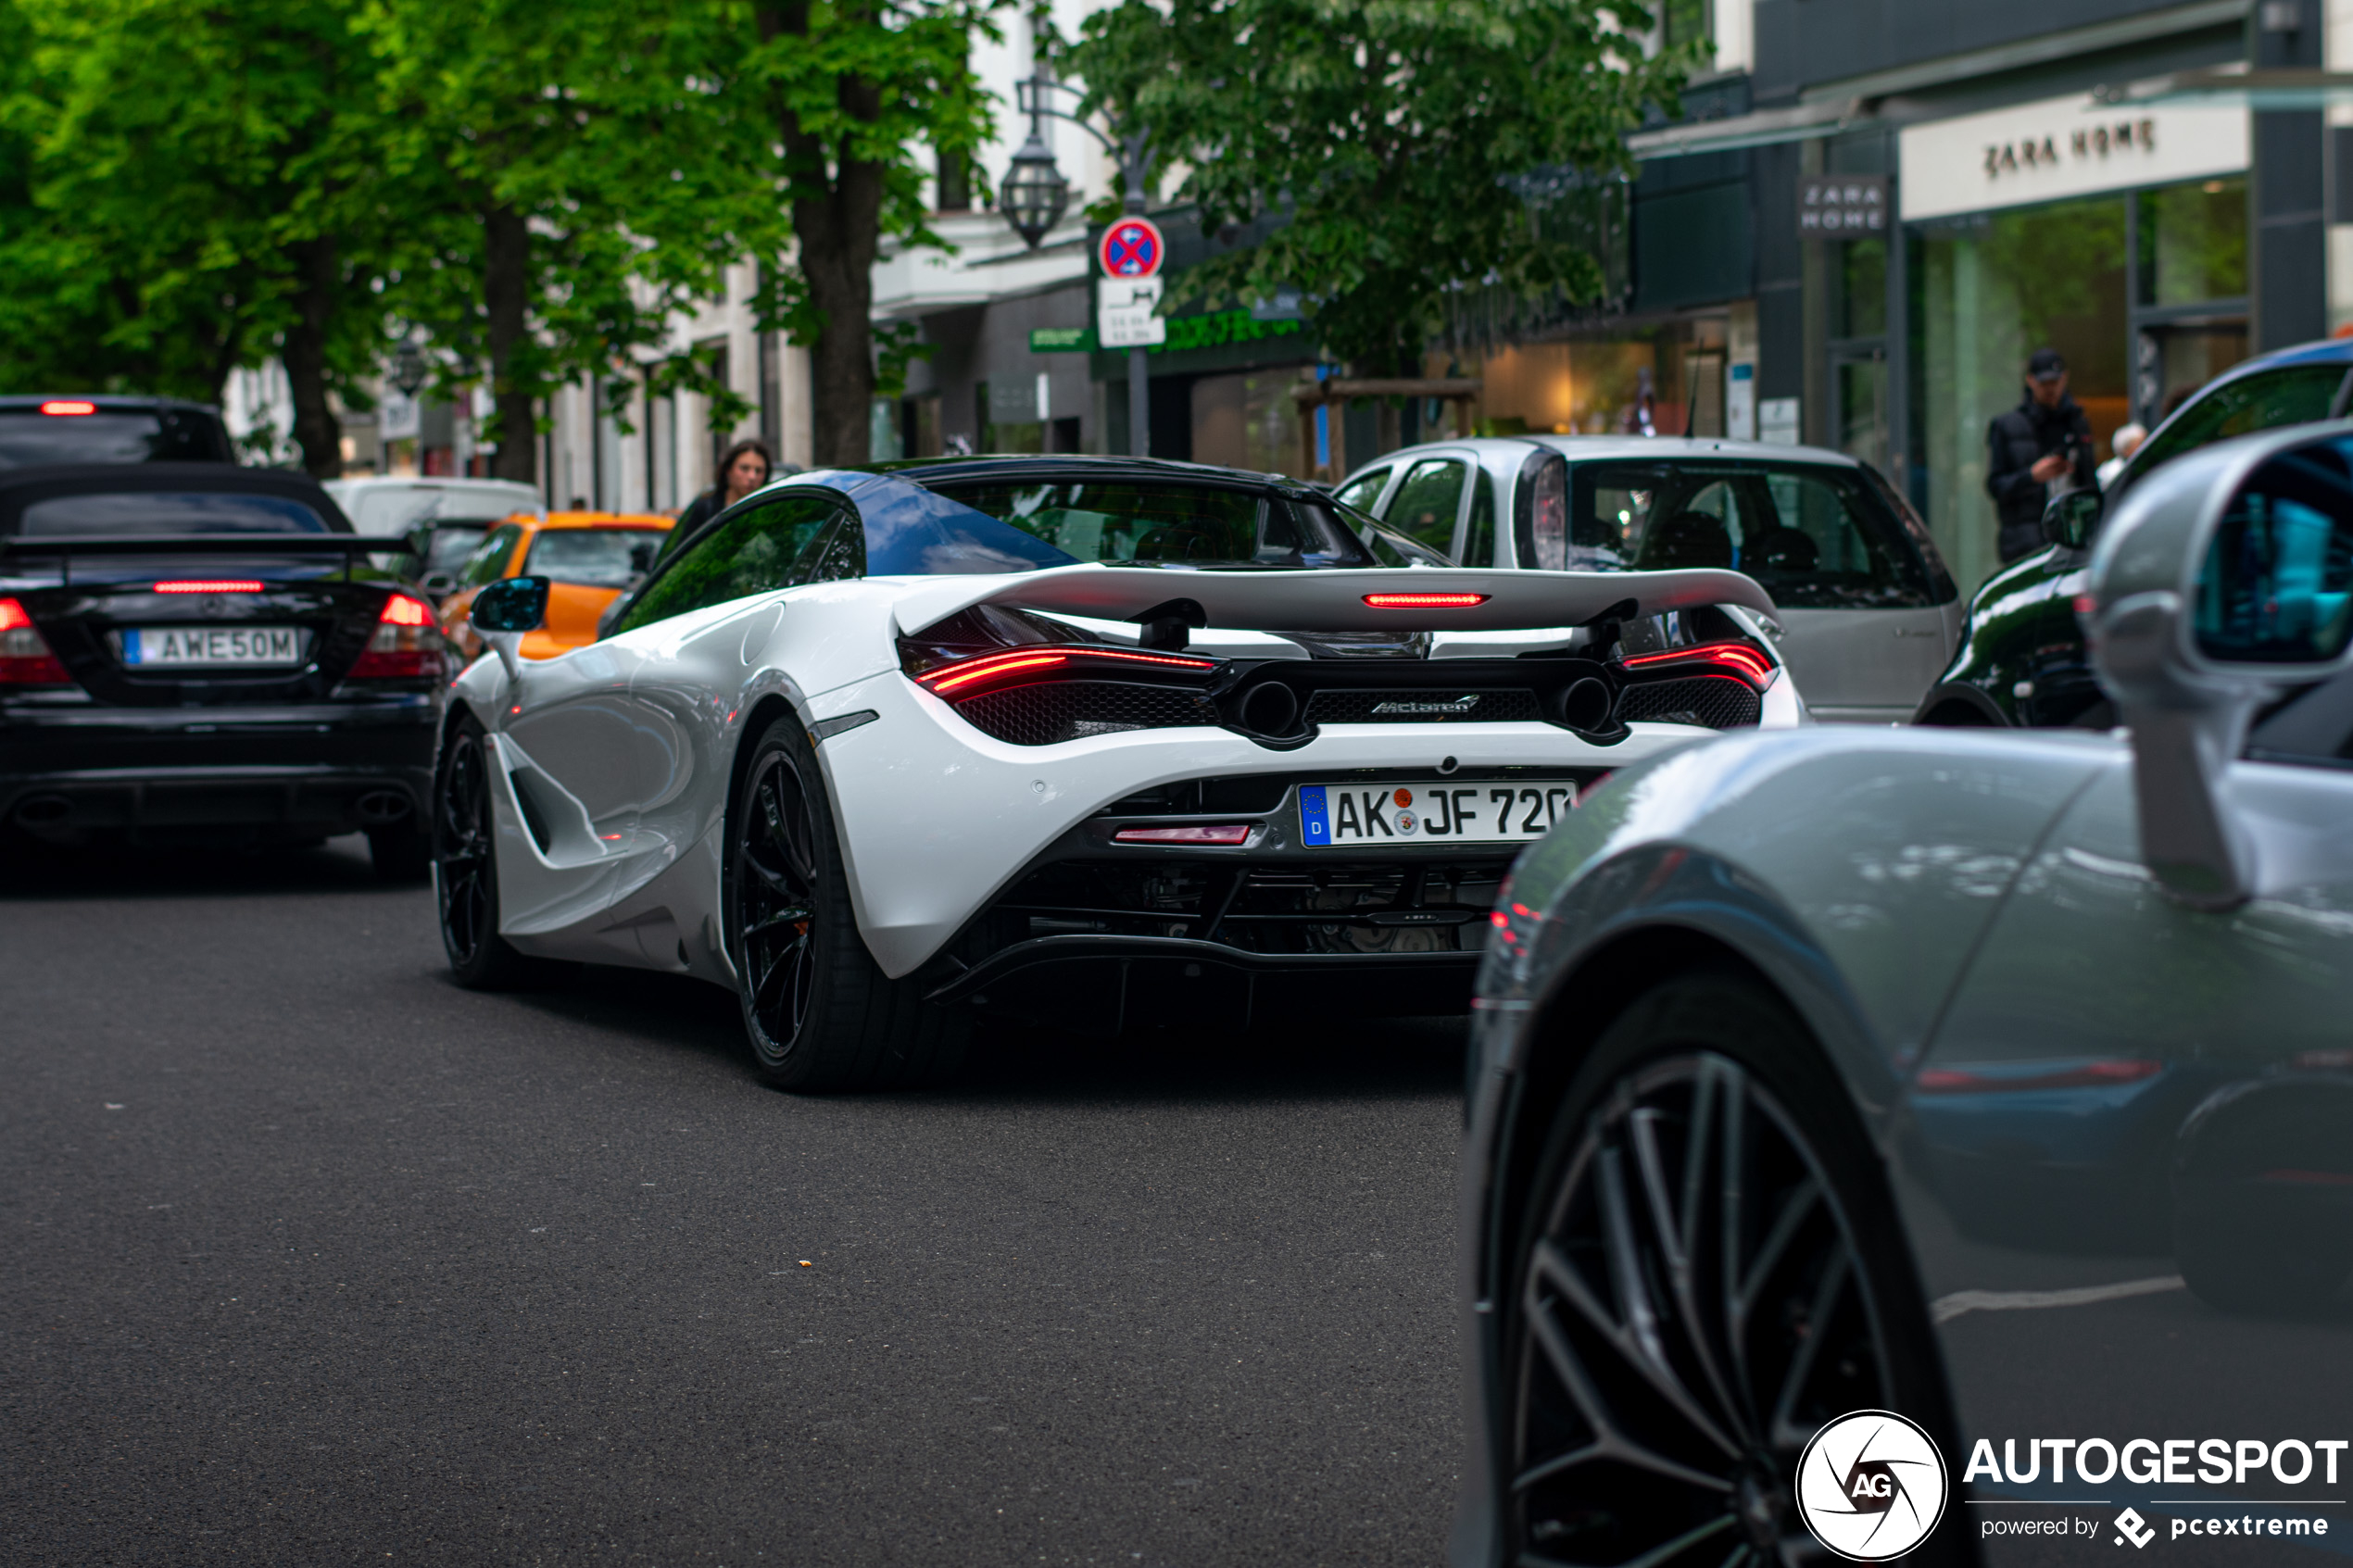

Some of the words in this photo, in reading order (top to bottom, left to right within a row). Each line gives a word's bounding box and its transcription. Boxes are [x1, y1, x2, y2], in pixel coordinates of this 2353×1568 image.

[1984, 136, 2058, 178] ZARA
[2071, 119, 2155, 157] HOME
[1805, 185, 1883, 205] ZARA
[1801, 209, 1886, 230] HOME
[1371, 700, 1471, 713] McLaren
[1336, 791, 1394, 838] AK
[1424, 789, 1478, 834] JF
